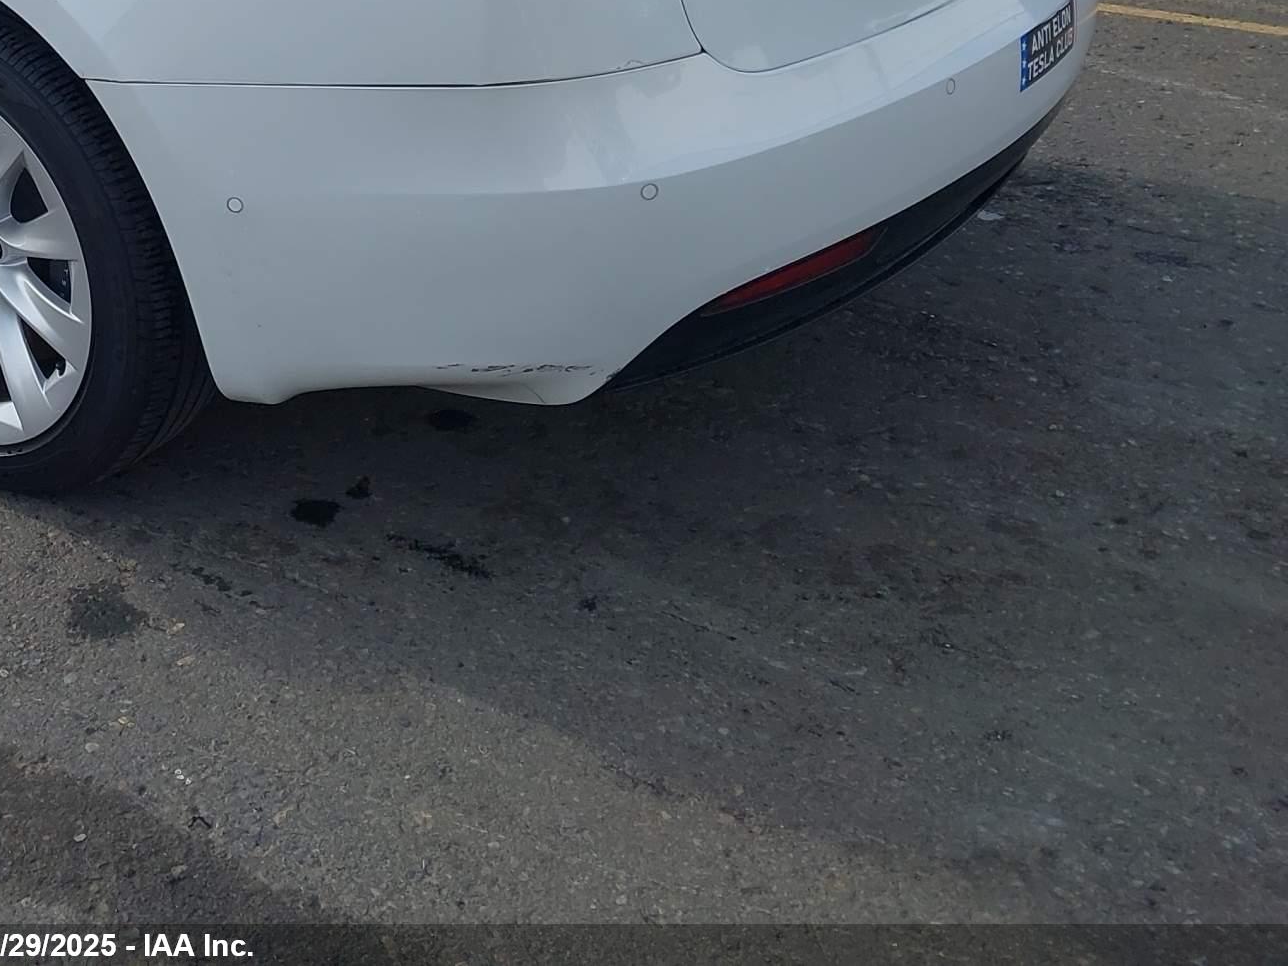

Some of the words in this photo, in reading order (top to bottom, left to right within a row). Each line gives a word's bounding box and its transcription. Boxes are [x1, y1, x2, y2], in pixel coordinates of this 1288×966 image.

[1028, 45, 1055, 81] TESLA
[1056, 27, 1073, 58] CLUB
[1032, 22, 1052, 55] ANTI
[1052, 5, 1071, 37] ELON
